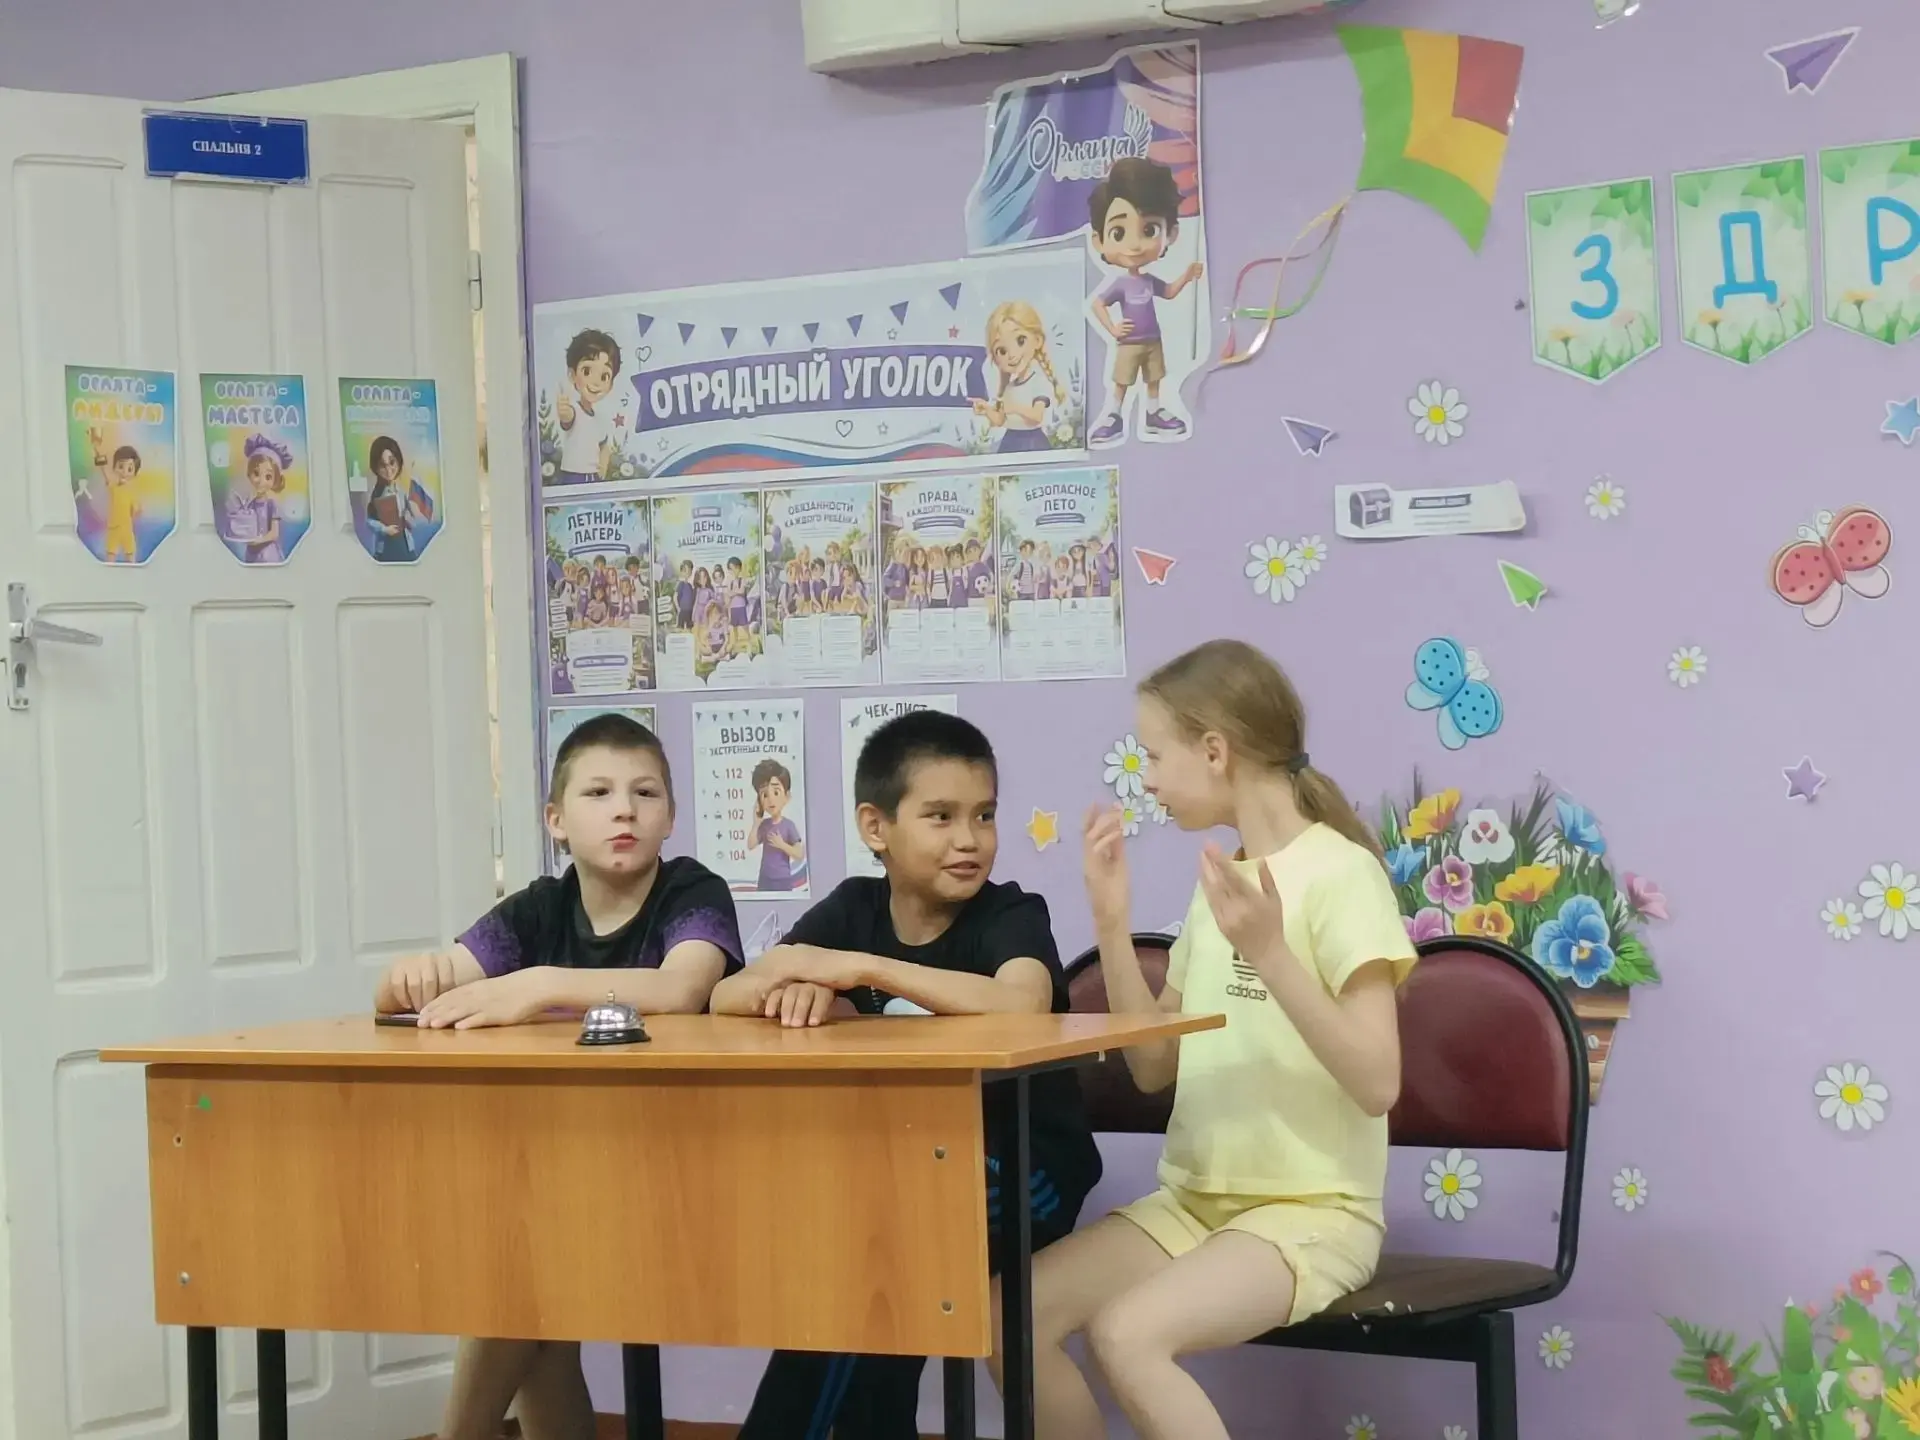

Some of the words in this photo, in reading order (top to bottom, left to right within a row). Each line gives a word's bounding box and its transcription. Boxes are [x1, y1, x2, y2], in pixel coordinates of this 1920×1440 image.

[192, 140, 251, 155] СПАЛЬНЯ
[254, 144, 262, 155] 2
[650, 353, 831, 419] ОТРЯДНЫЙ
[842, 355, 973, 400] УГОЛОК
[208, 404, 299, 427] МАСТЕРА
[918, 490, 958, 504] ПРАВА
[1025, 484, 1096, 502] БЕЗОПАСНОЕ
[788, 500, 854, 516] ОБЯЗАННОСТИ
[1044, 498, 1077, 512] ЛЕТО
[567, 510, 623, 531] ЛЕТНИЙ
[693, 520, 723, 535] ДЕНЬ
[574, 527, 622, 545] ЛАГЕРЬ
[676, 535, 715, 548] ЗАЩИТЫ
[720, 726, 776, 744] ВЫЗОВ
[725, 768, 743, 779] 112
[727, 788, 744, 799] 101
[728, 809, 744, 820] 102
[729, 830, 745, 840] 103
[730, 850, 746, 861] 104
